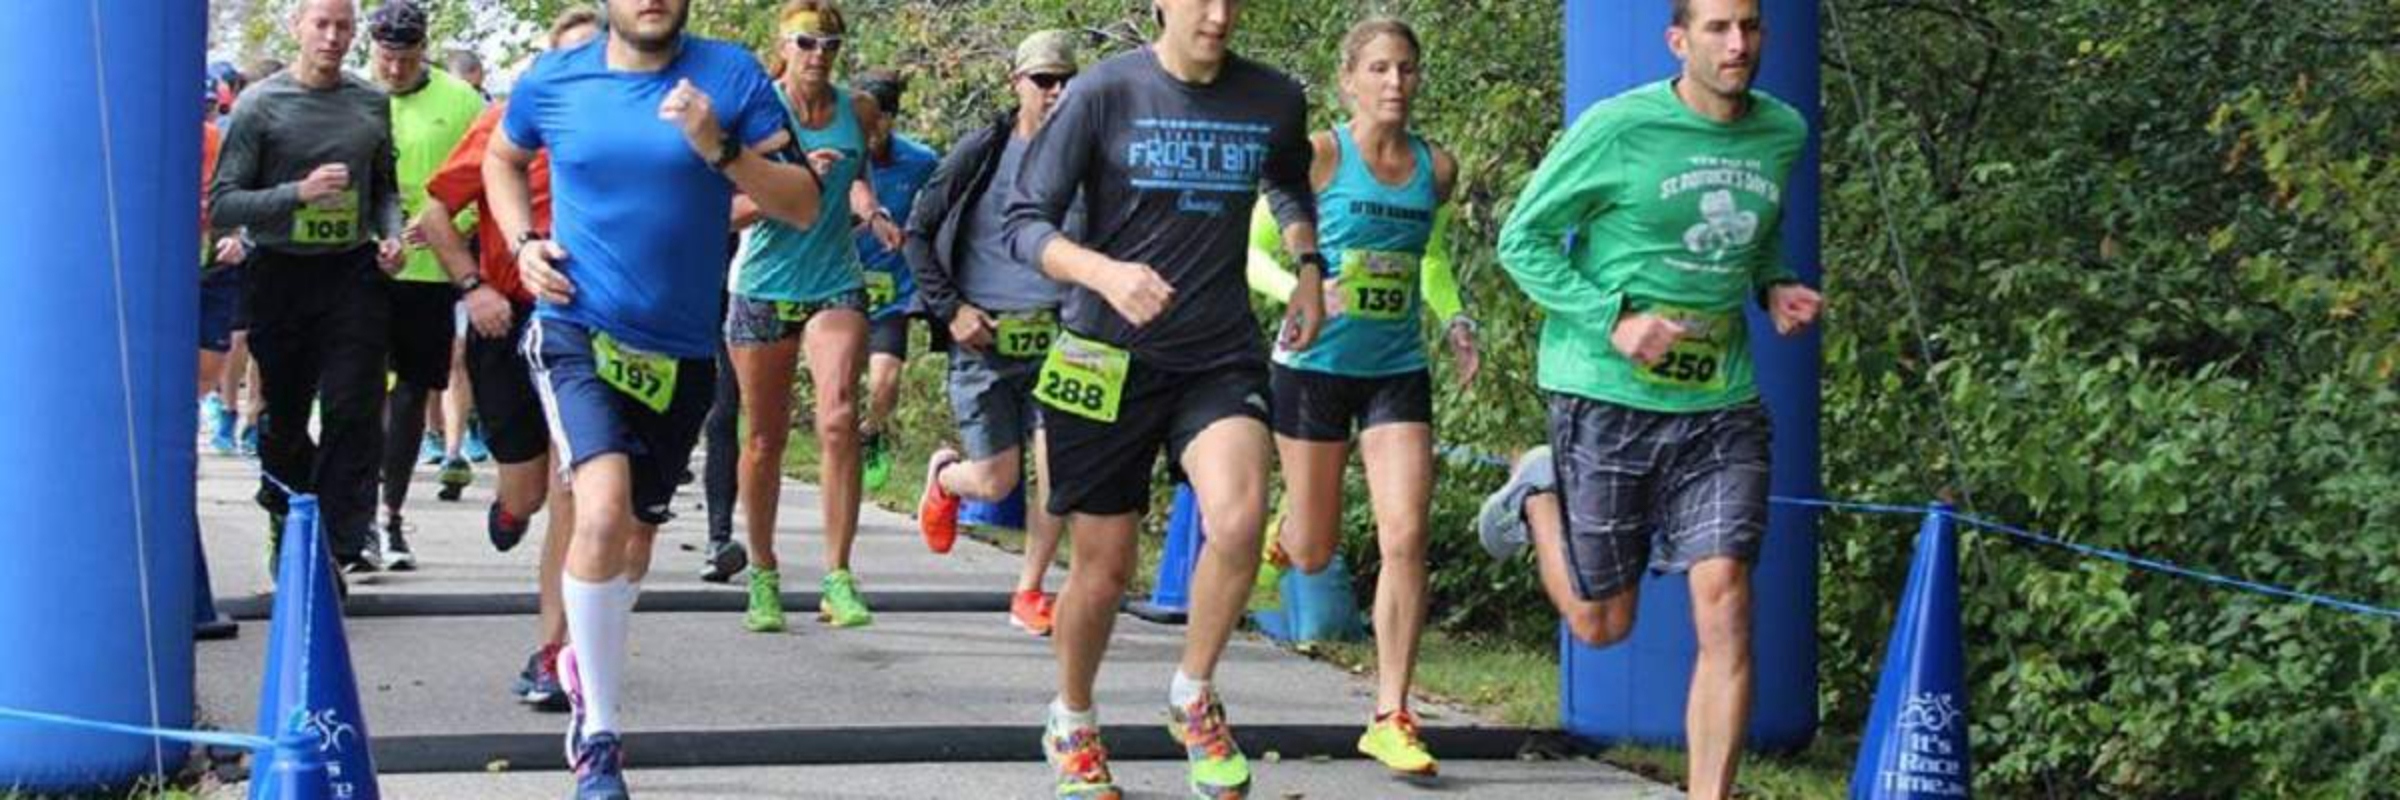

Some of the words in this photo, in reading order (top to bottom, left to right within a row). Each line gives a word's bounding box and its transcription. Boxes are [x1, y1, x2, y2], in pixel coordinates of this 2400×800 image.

[1128, 138, 1215, 171] FROST
[1356, 287, 1405, 313] 139
[1008, 331, 1050, 352] 170
[609, 359, 662, 399] 197
[1650, 350, 1717, 383] 250
[1043, 370, 1105, 411] 288
[1911, 732, 1952, 755] It's
[1899, 752, 1960, 775] Race
